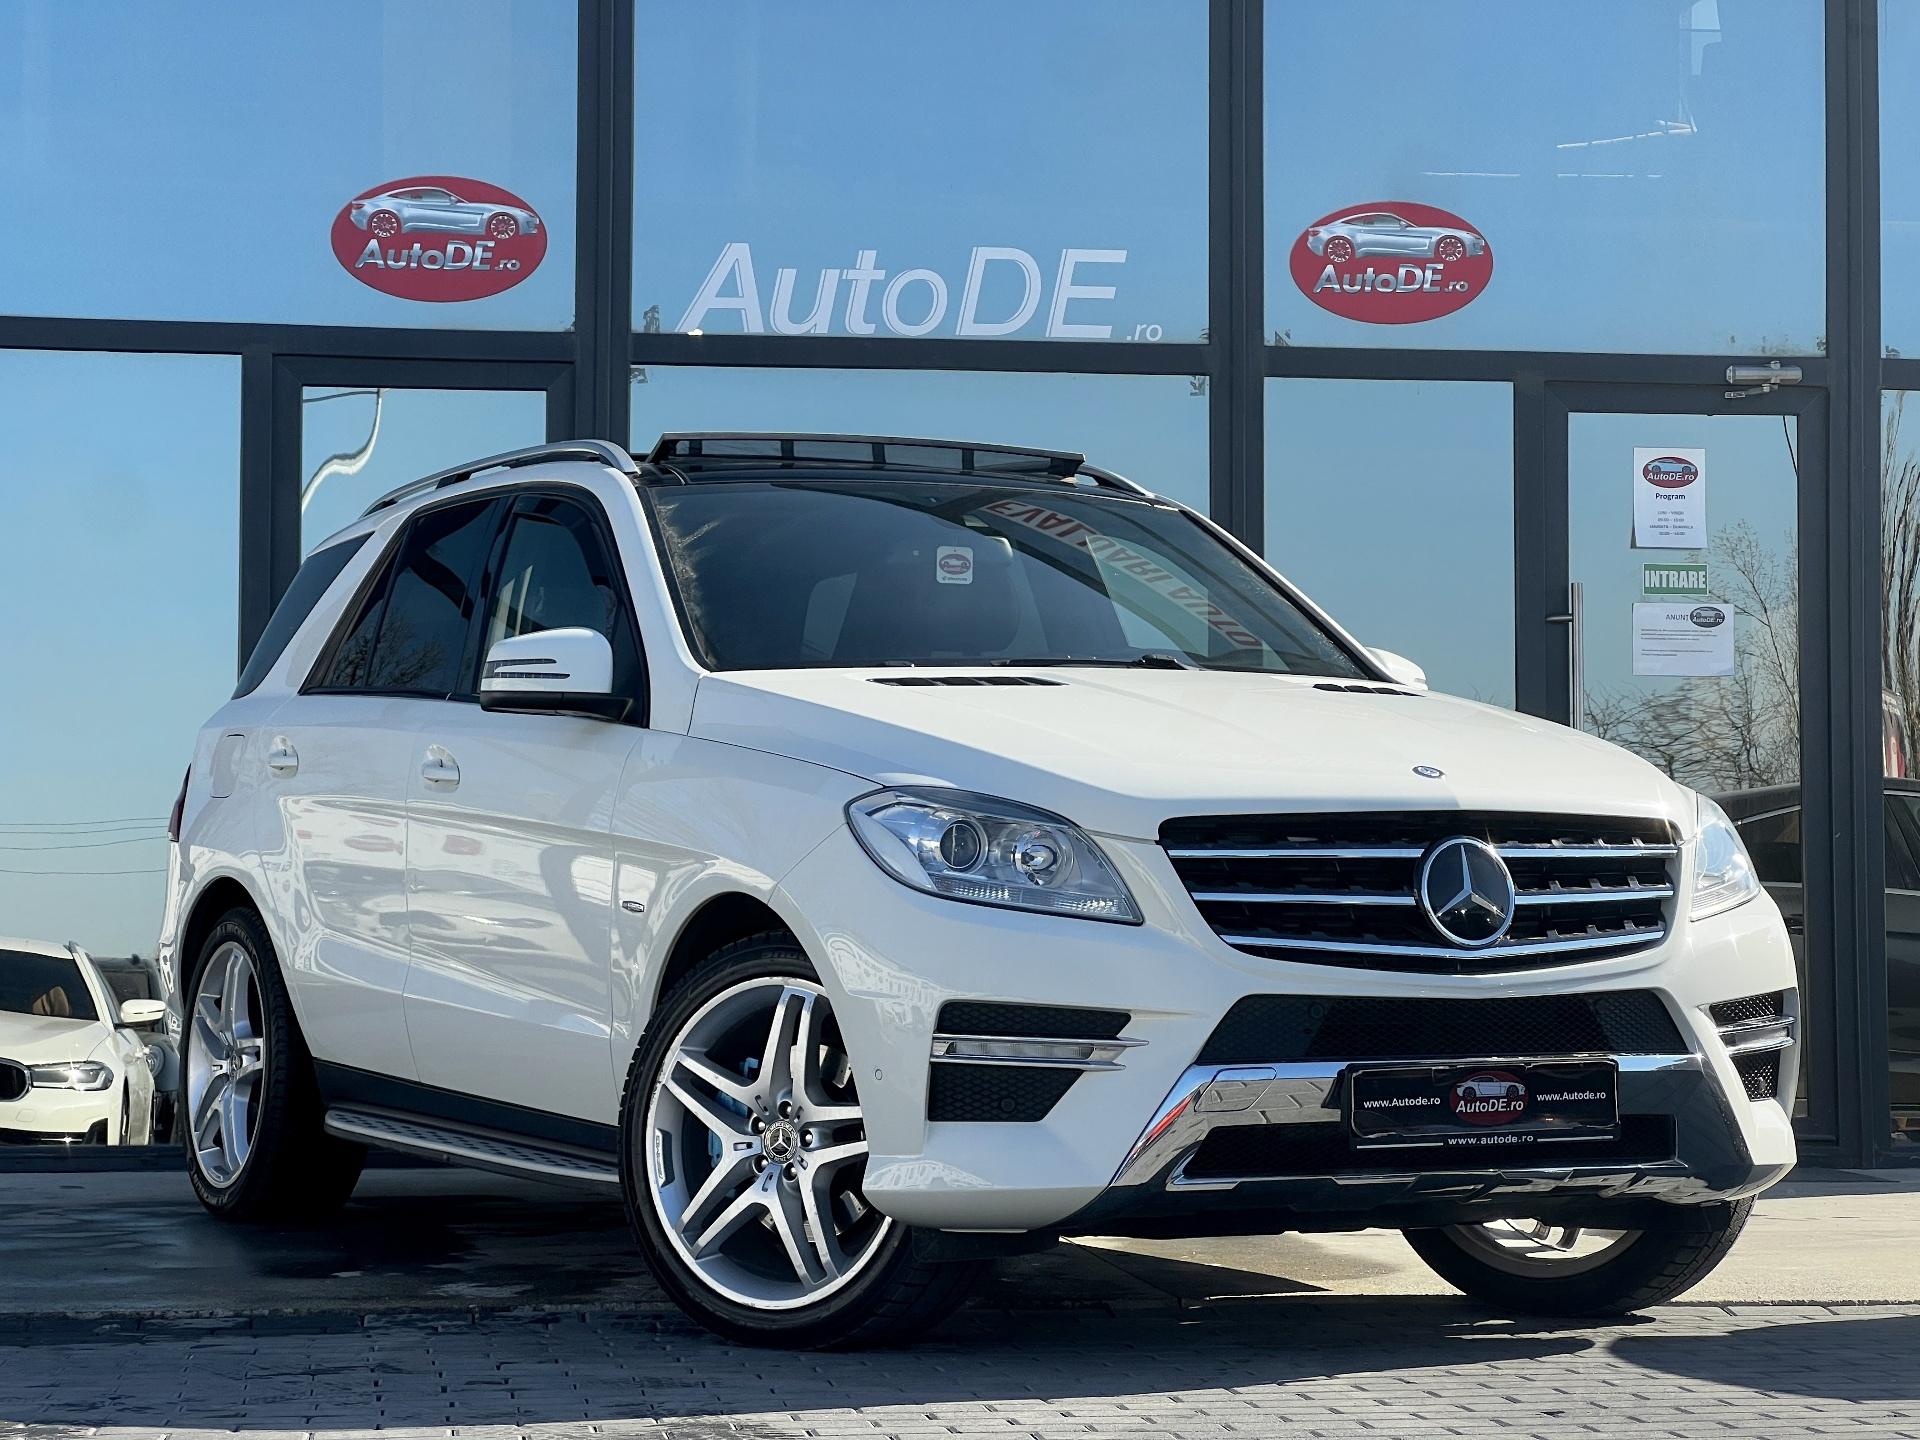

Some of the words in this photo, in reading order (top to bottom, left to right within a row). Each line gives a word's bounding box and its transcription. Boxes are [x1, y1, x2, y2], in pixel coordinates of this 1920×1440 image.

[1646, 472, 1695, 483] AutoDE.ro
[1655, 492, 1686, 501] Program
[1644, 570, 1706, 589] INTRARE
[1363, 1096, 1441, 1109] www.Autode.ro
[1536, 1090, 1607, 1102] www.Autode.ro
[1456, 1098, 1524, 1114] AutoDE.ro
[1447, 1133, 1534, 1146] www.autode.ro
